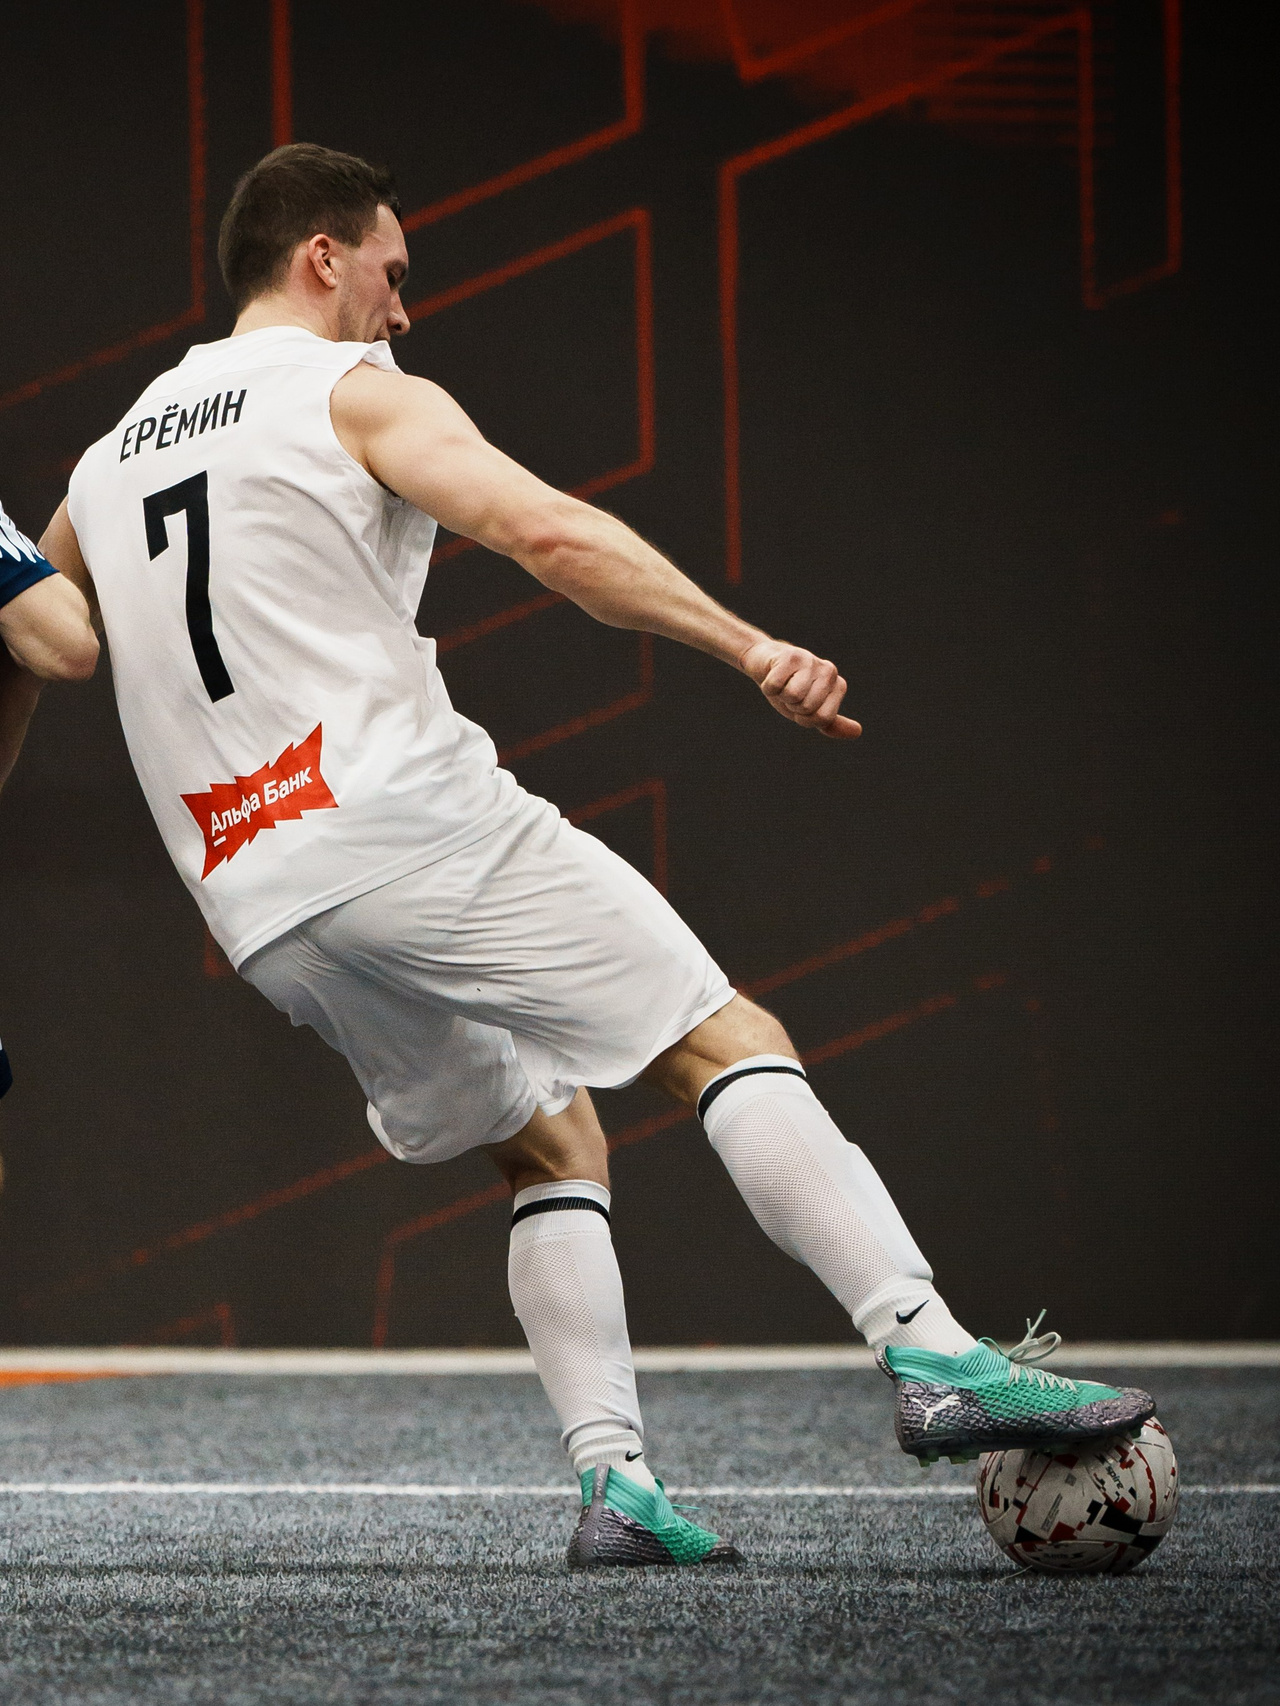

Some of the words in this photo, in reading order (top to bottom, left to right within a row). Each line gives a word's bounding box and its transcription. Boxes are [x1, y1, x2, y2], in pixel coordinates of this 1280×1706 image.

[120, 389, 247, 463] ЕРЁМИН
[142, 470, 235, 704] 7
[210, 794, 261, 839] Альфа
[263, 766, 313, 806] Банк
